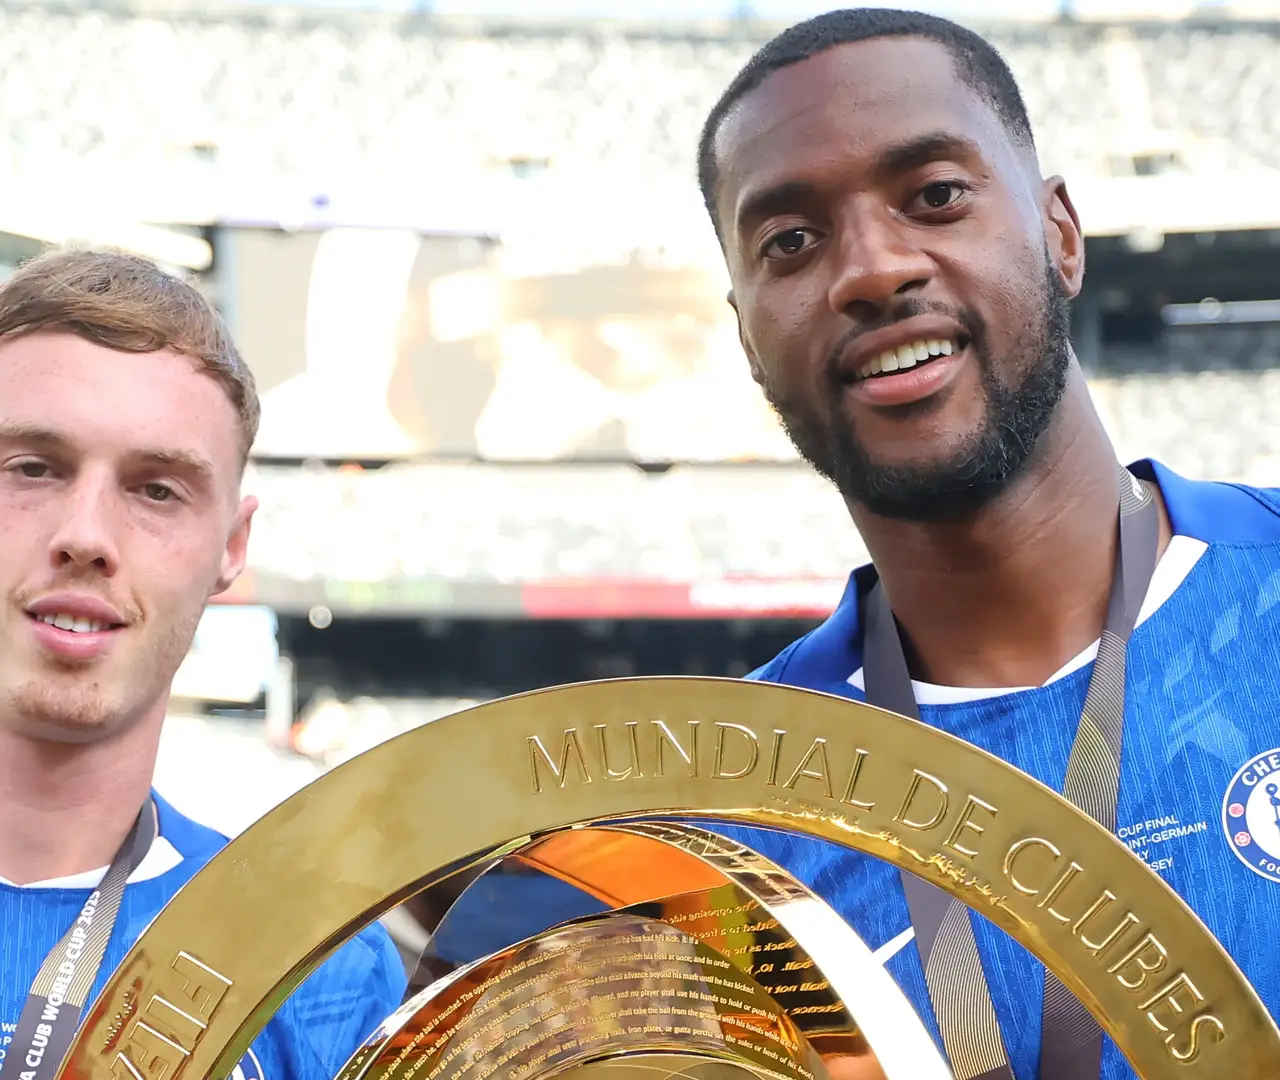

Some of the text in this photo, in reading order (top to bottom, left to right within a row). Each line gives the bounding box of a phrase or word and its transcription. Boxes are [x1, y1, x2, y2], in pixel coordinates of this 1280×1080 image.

[1118, 815, 1179, 838] CUP FINAL
[1124, 821, 1207, 850] INT-GERMAIN
[77, 890, 101, 927] 2025
[525, 719, 1225, 1065] MUNDIAL DE CLUBES
[69, 924, 89, 960] CUP
[41, 957, 77, 1022] WORLD
[700, 992, 719, 1002] hands
[719, 996, 727, 1004] to
[727, 998, 743, 1008] hold
[751, 1006, 767, 1018] push
[767, 1012, 778, 1020] his
[25, 1024, 53, 1069] CLUB
[386, 1057, 403, 1075] place
[399, 1040, 416, 1059] where
[413, 1031, 424, 1043] the
[422, 1022, 434, 1034] ball
[432, 1017, 440, 1025] is
[437, 999, 462, 1021] touched.
[460, 990, 473, 1003] The
[403, 1067, 415, 1079] fair
[412, 1053, 428, 1070] catch
[434, 1033, 449, 1048] shall
[447, 1027, 456, 1036] be
[725, 1033, 737, 1042] the
[737, 1037, 754, 1048] soles
[762, 1047, 779, 1059] heels
[778, 1055, 788, 1063] of
[786, 1059, 798, 1069] his
[797, 1065, 817, 1080] boots.
